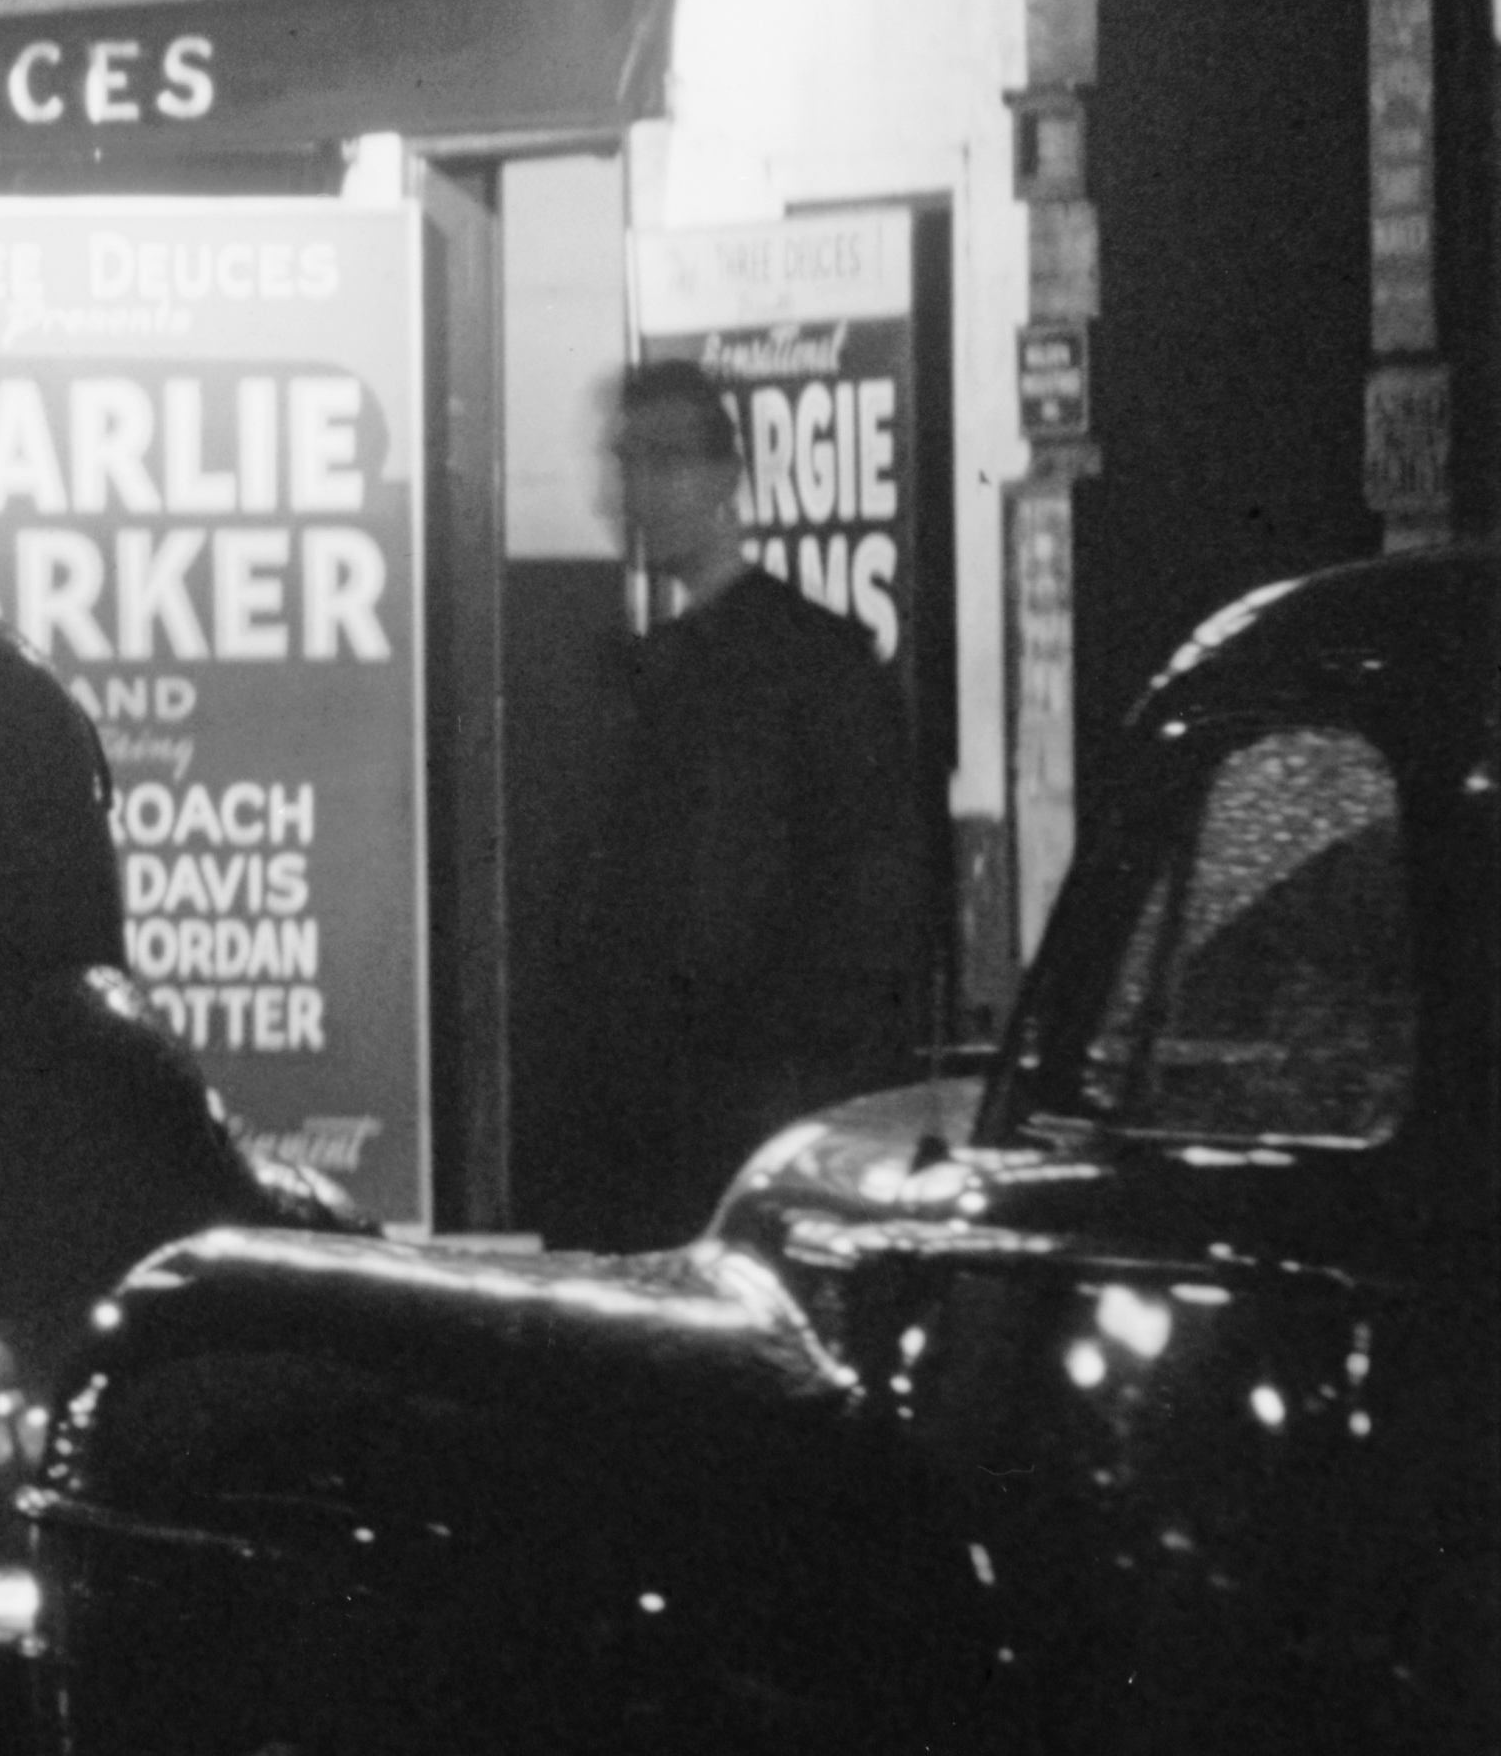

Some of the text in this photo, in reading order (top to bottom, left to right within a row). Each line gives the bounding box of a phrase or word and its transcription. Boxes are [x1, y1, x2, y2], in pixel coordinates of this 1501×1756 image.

[719, 376, 897, 527] RGIE
[125, 852, 310, 914] DAVIS
[150, 986, 327, 1052] OTTER
